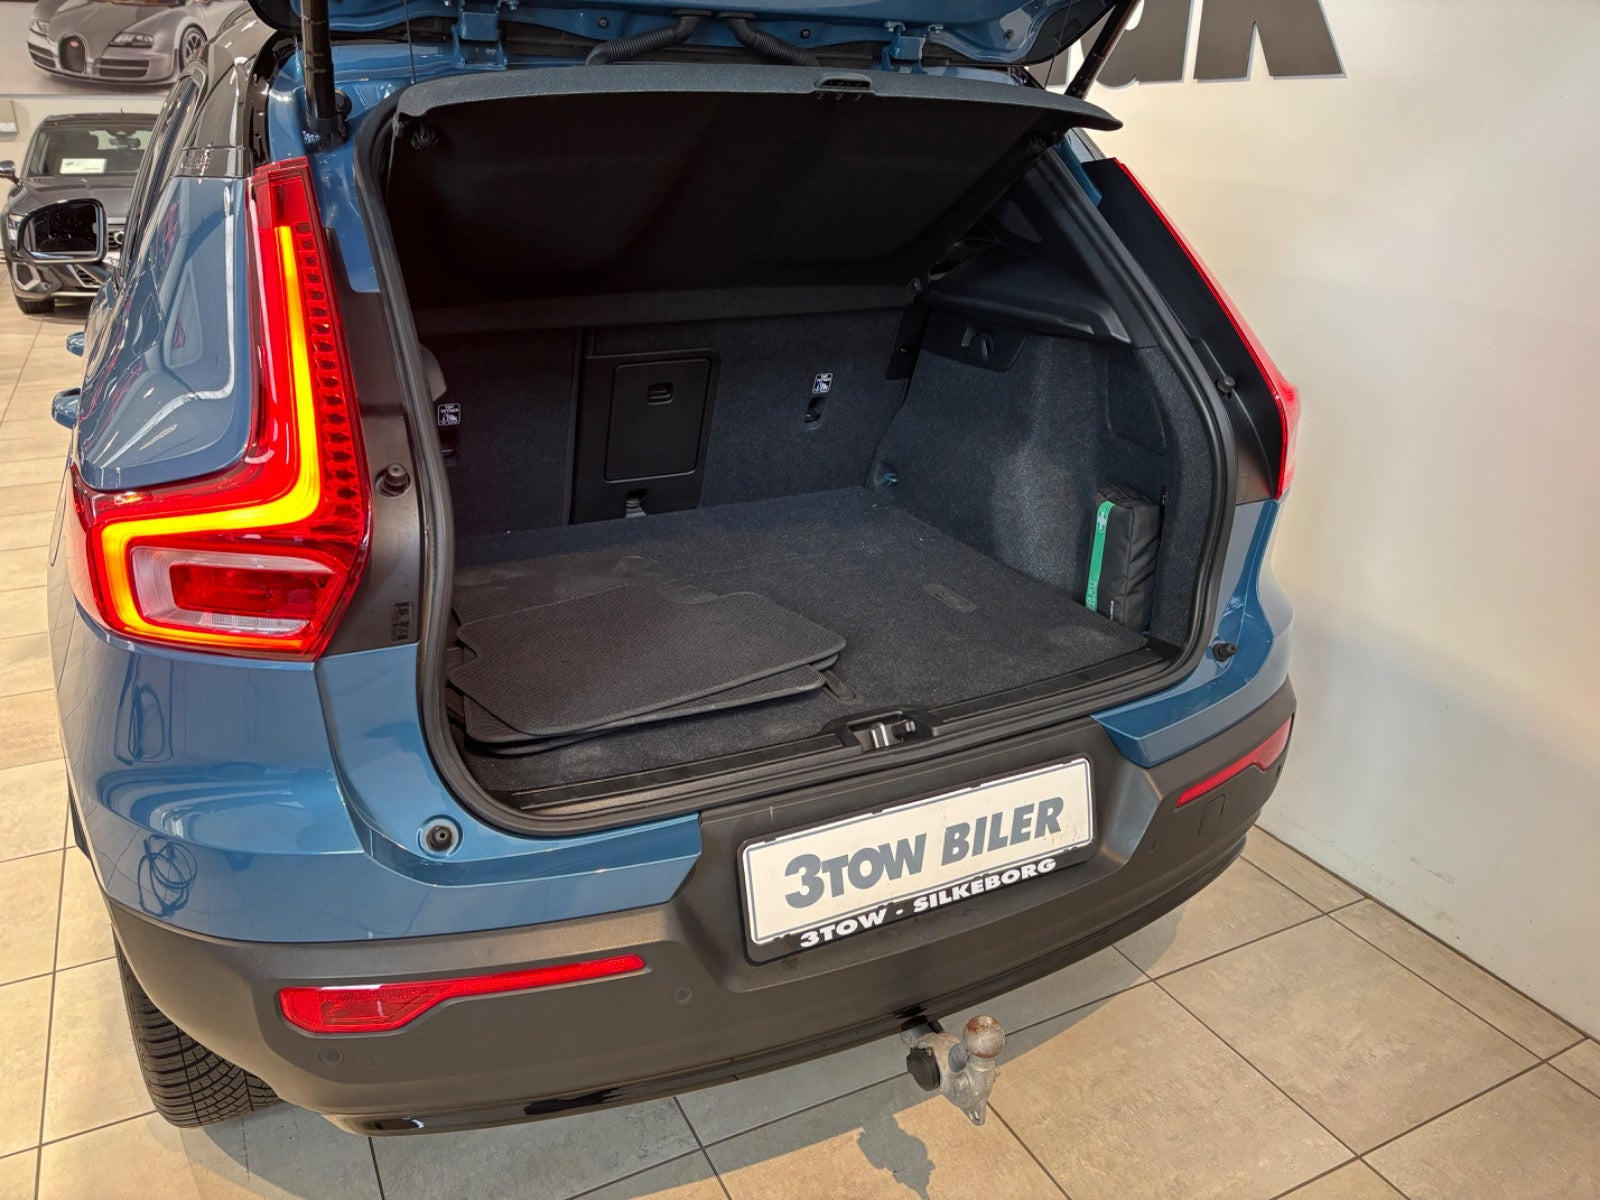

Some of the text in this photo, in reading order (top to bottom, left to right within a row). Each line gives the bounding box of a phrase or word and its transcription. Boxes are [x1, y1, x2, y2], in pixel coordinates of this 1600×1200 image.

[785, 796, 1064, 909] 3TOW BILER
[800, 908, 887, 948] 3TOW
[913, 858, 1056, 913] SILKEBORG
